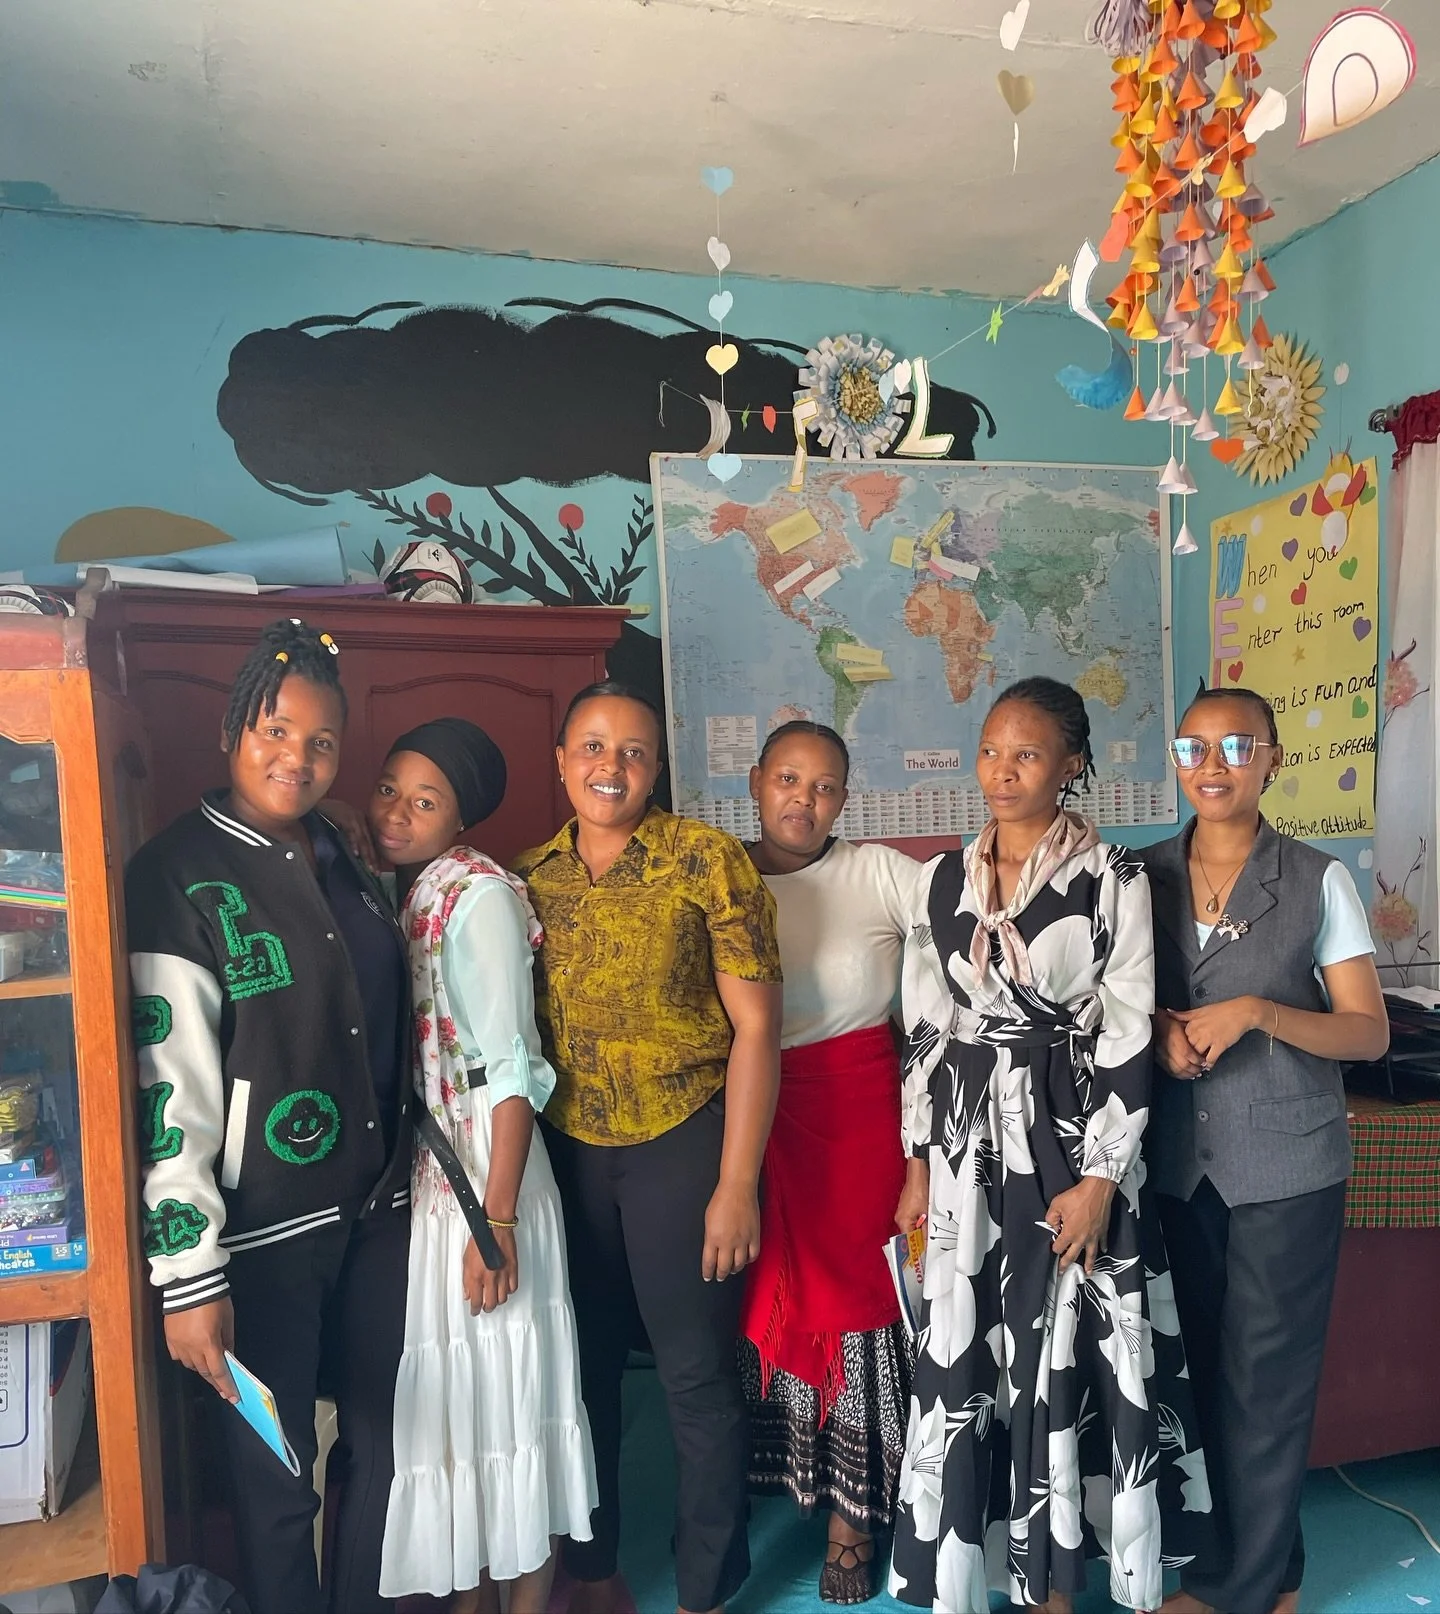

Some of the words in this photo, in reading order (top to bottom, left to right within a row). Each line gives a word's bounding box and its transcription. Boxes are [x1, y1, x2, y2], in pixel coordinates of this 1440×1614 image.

[1216, 534, 1278, 599] When
[1214, 598, 1283, 659] Enter
[1294, 611, 1324, 634] this
[1333, 601, 1365, 623] room
[1291, 686, 1308, 708] is
[905, 758, 926, 769] The
[927, 756, 959, 768] World
[1308, 743, 1321, 763] is
[3, 1250, 33, 1260] English
